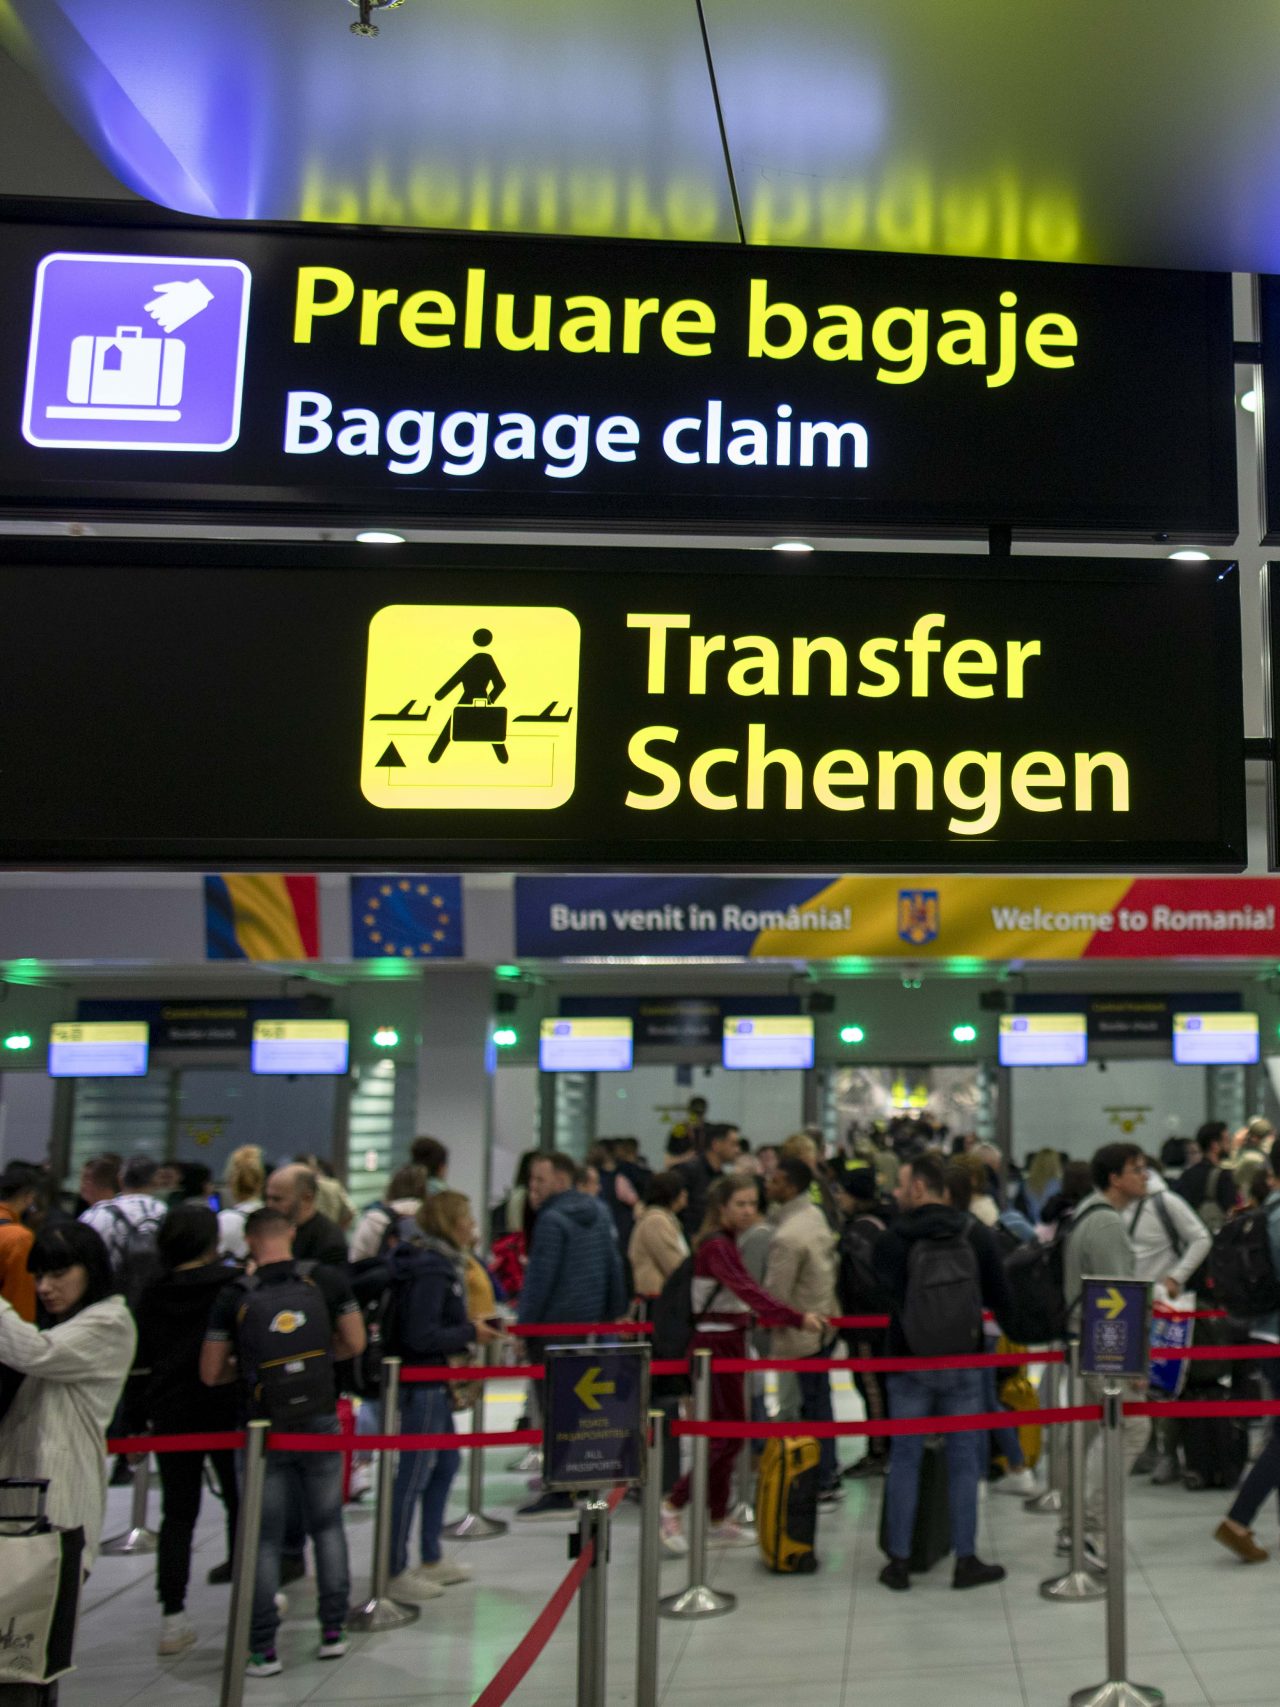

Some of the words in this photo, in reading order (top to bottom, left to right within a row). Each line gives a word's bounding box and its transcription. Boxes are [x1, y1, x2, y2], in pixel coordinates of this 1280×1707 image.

[292, 266, 717, 358] Preluare
[747, 278, 1079, 389] bagaje
[282, 389, 641, 479] Baggage
[661, 398, 869, 470] claim
[625, 611, 1043, 701] Transfer
[624, 723, 1131, 837] Schengen
[550, 904, 607, 931] Bun
[612, 904, 685, 931] venit
[689, 904, 720, 931] în
[722, 904, 851, 931] România!
[991, 905, 1113, 932] Welcome
[1118, 907, 1149, 932] to
[1152, 904, 1275, 931] Romania!
